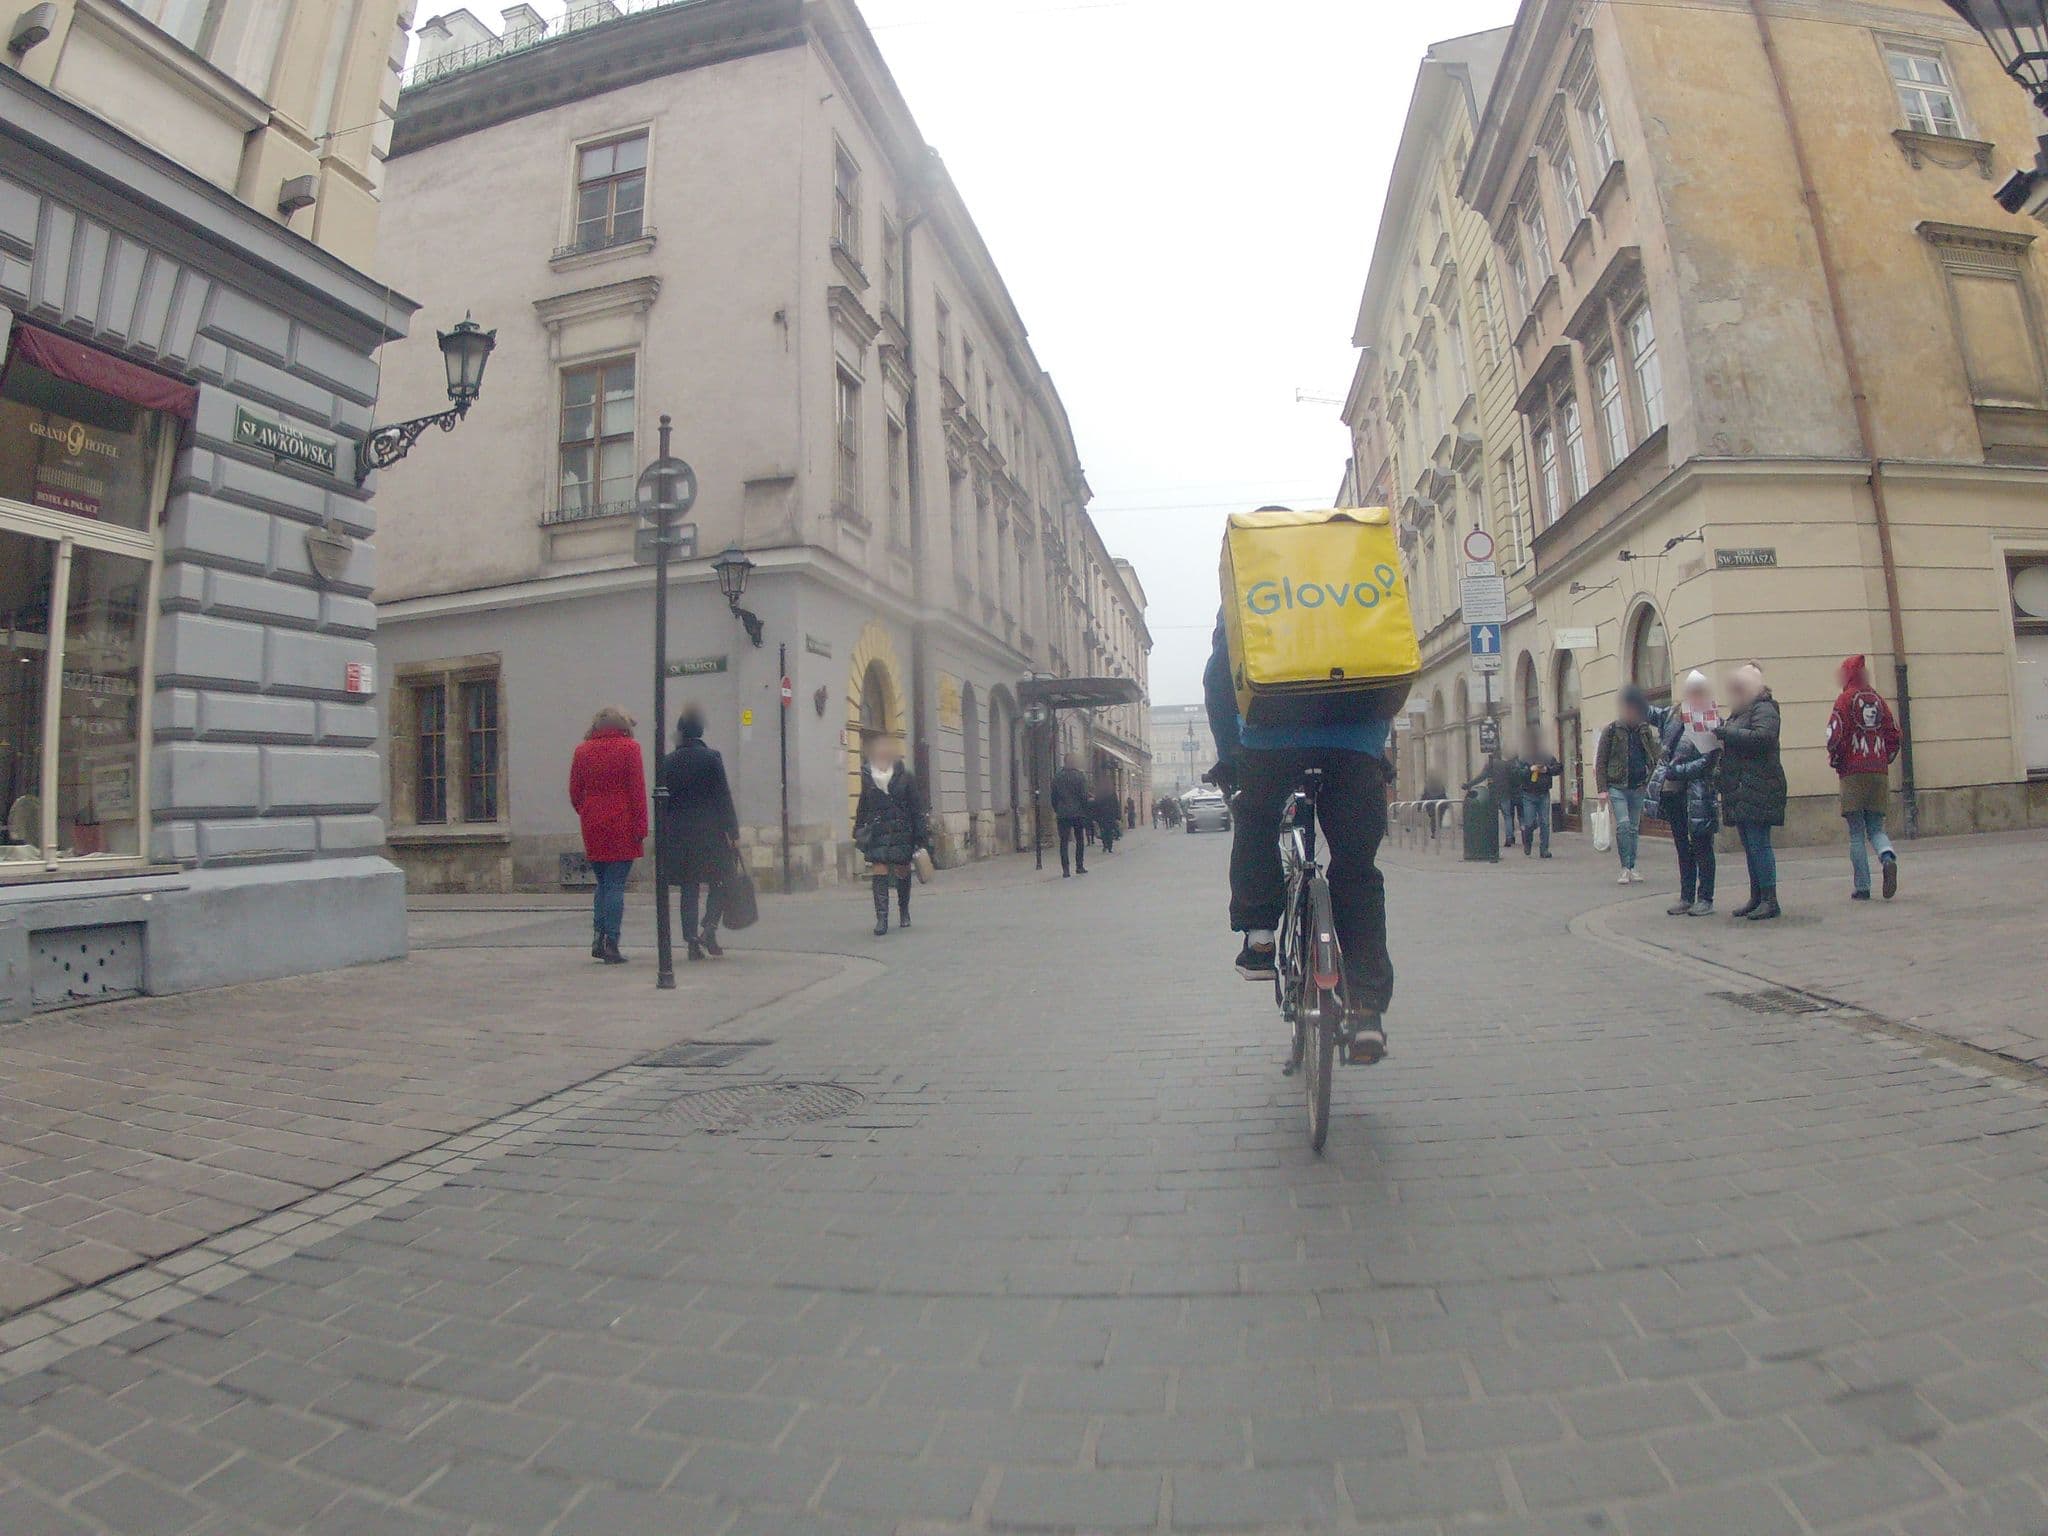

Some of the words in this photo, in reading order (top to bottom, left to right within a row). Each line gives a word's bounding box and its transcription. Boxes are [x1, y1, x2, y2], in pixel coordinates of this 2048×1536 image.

[30, 423, 67, 442] GRAND
[85, 439, 121, 459] HOTEL
[241, 420, 334, 469] SŁAWKOWSKA
[1735, 555, 1775, 565] TOMASZA
[1246, 575, 1380, 616] Glovo
